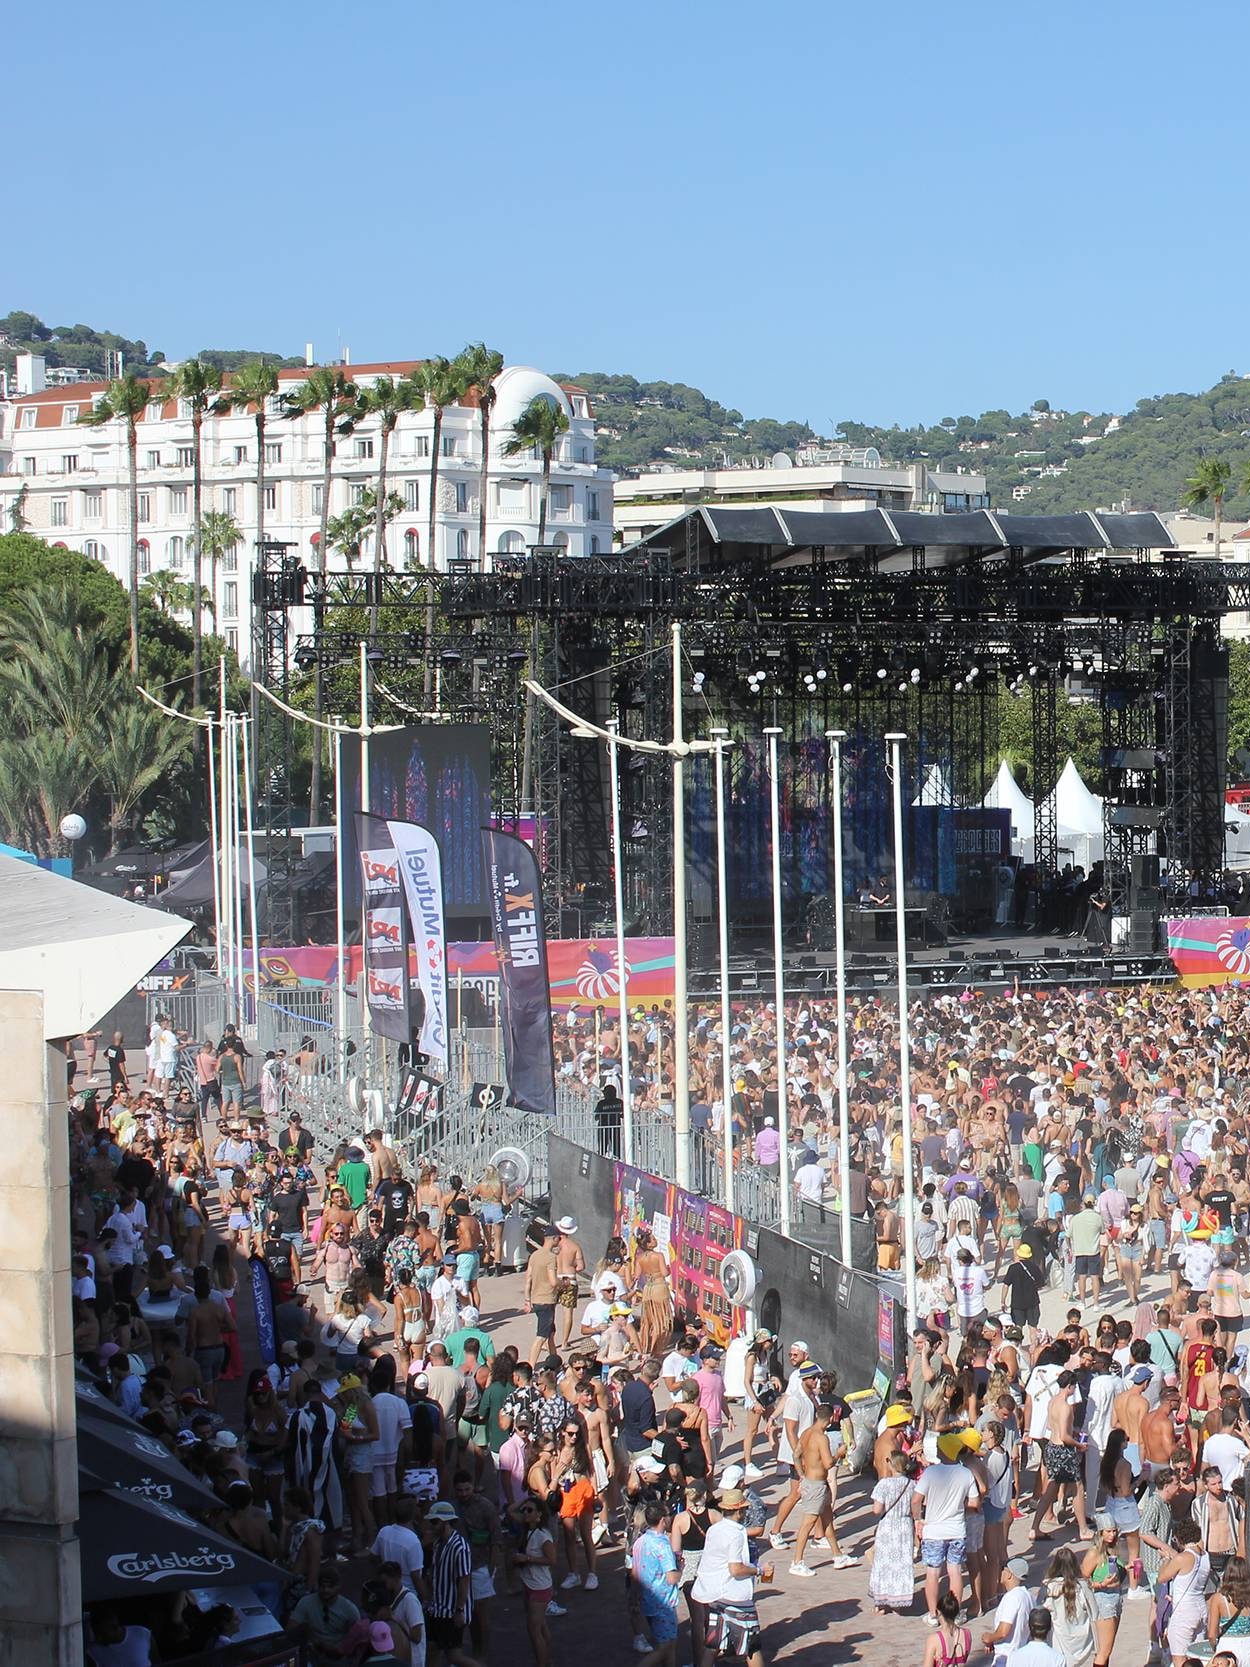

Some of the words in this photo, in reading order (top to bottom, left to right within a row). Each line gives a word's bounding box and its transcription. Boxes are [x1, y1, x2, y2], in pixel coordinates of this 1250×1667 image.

[137, 974, 190, 991] RIFFX
[1194, 1359, 1206, 1376] 23
[107, 1550, 235, 1582] Carlsberg
